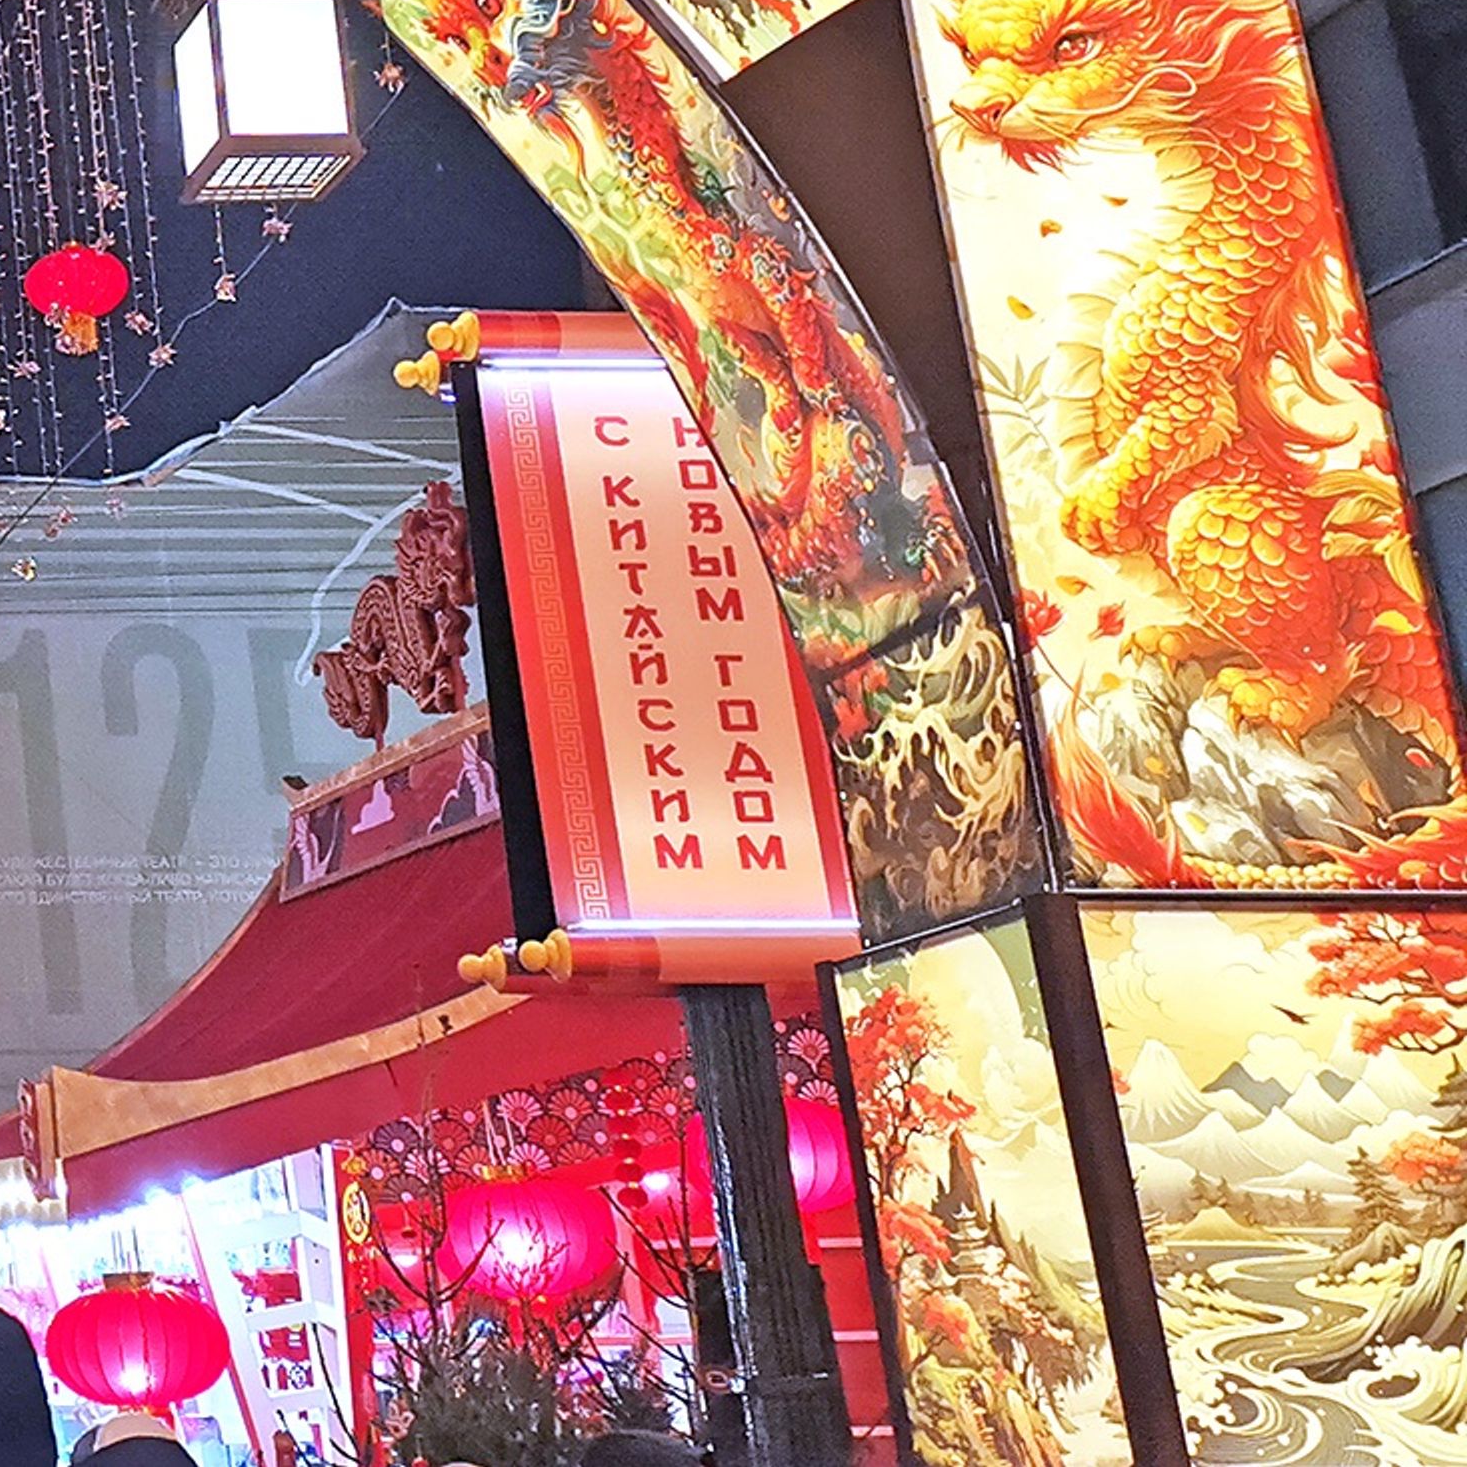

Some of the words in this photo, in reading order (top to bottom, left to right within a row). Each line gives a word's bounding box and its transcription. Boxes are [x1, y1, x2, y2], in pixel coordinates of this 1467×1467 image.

[594, 416, 630, 446] С
[602, 476, 703, 870] КИТАЙСКИМ
[672, 417, 744, 622] НОВЫМ
[713, 655, 787, 871] ГОДОМ
